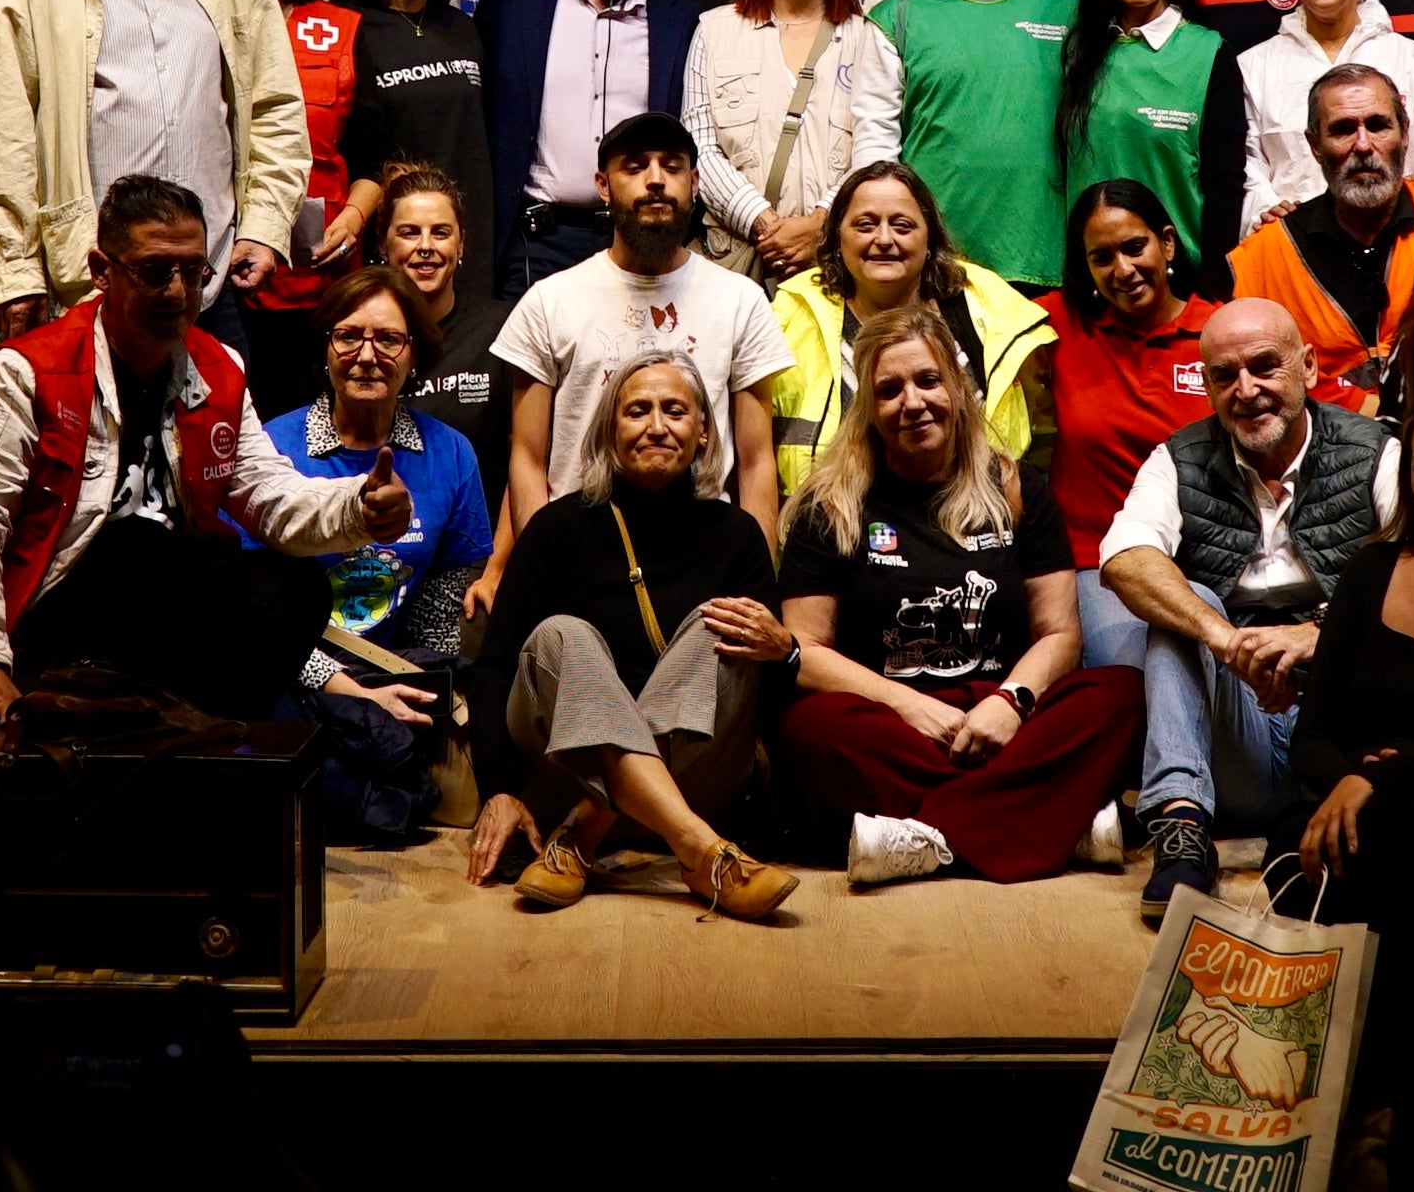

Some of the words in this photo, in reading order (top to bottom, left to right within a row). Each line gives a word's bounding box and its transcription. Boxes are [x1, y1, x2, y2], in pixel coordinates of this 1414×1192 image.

[375, 61, 448, 88] ASPRONA
[458, 371, 490, 384] Plena
[875, 529, 891, 545] H
[1184, 941, 1230, 975] El
[1221, 949, 1329, 999] COMERCIO
[1152, 1106, 1293, 1139] SALVA
[1124, 1131, 1161, 1161] al
[1157, 1143, 1296, 1192] COMERCIO
